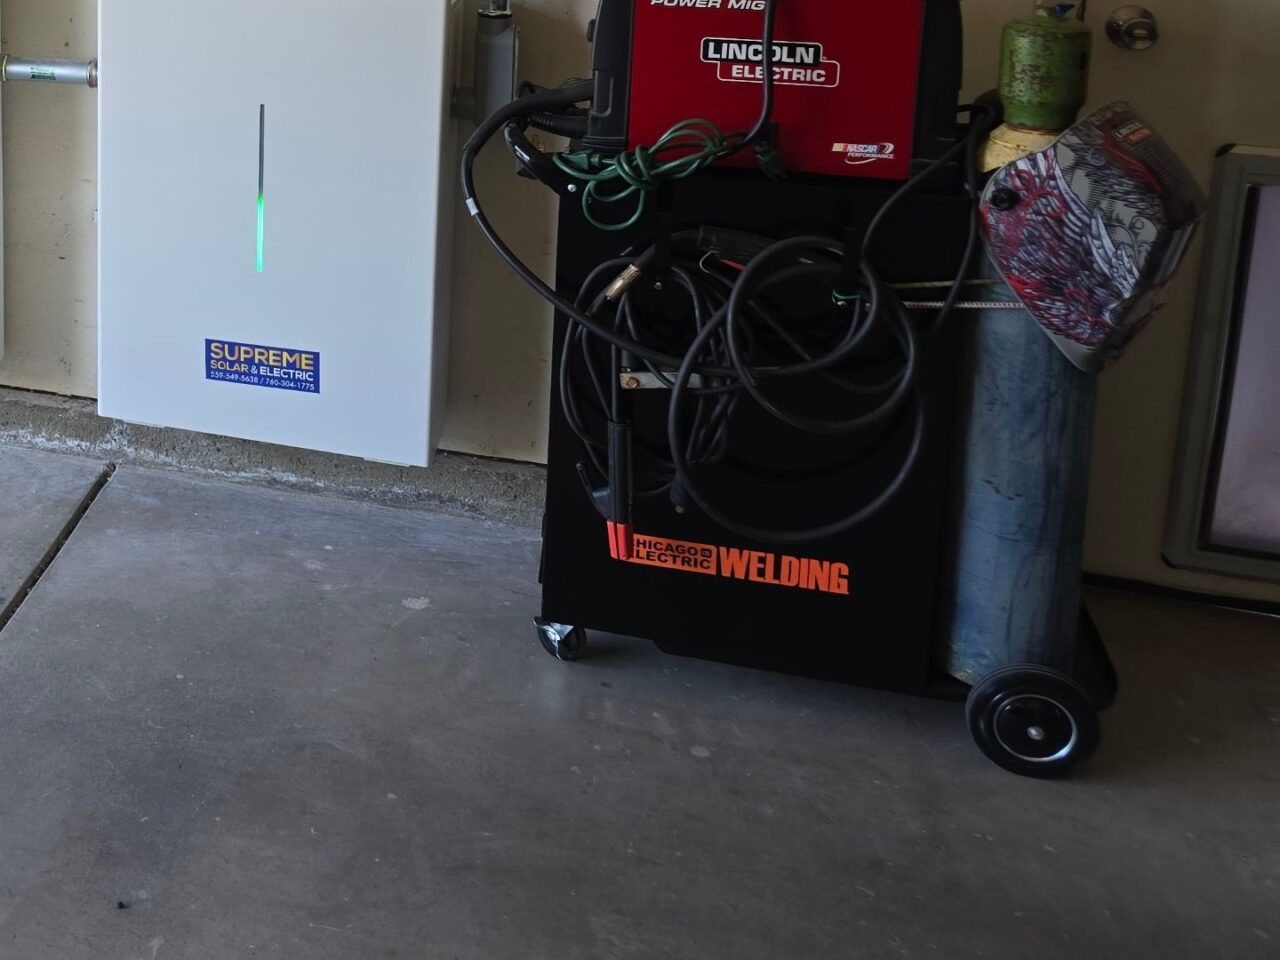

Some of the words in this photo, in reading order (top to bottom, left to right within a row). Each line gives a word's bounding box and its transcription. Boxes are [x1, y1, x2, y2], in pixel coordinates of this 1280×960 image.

[727, 0, 766, 11] MIG
[731, 64, 826, 82] ELECTRIC
[847, 143, 878, 153] NASCAR
[210, 342, 314, 370] SUPREME
[210, 359, 249, 373] SOLAR
[250, 364, 258, 375] &
[259, 366, 315, 381] ELECTRIC
[210, 370, 259, 383] 559-549-5638
[265, 378, 315, 390] 760-304-1775
[635, 548, 712, 570] LECTRIC
[635, 538, 699, 557] HICAGO
[719, 546, 850, 595] WELDING
